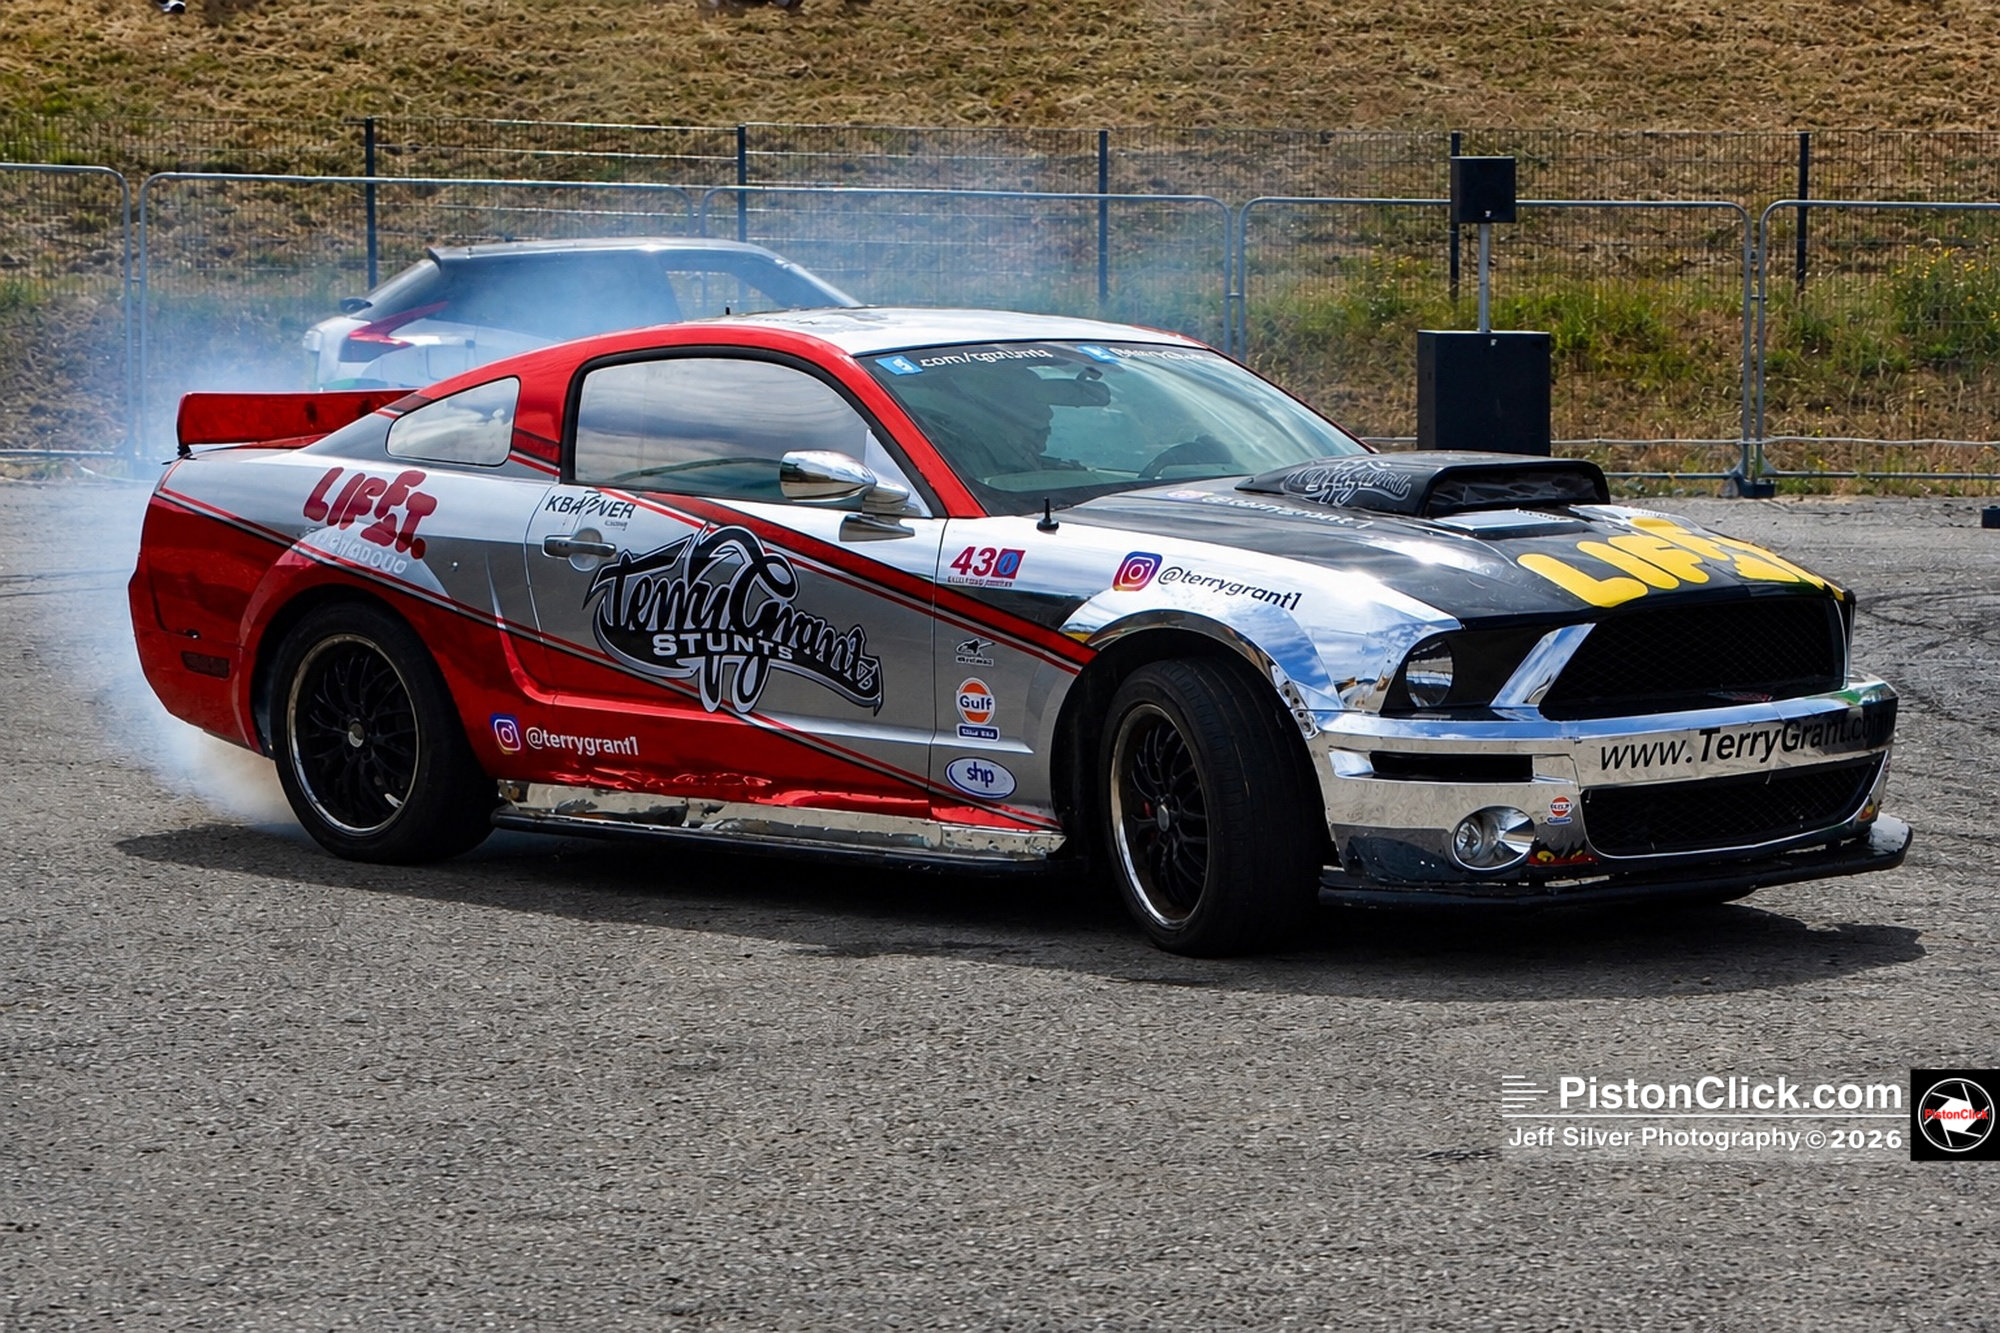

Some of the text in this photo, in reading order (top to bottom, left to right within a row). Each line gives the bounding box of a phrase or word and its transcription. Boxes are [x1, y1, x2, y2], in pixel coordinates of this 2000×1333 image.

[1158, 566, 1302, 611] @terrygrant1
[653, 633, 793, 661] STUNTS
[959, 694, 993, 711] Gulf
[526, 726, 639, 756] @terrygrant1
[966, 761, 995, 788] shp
